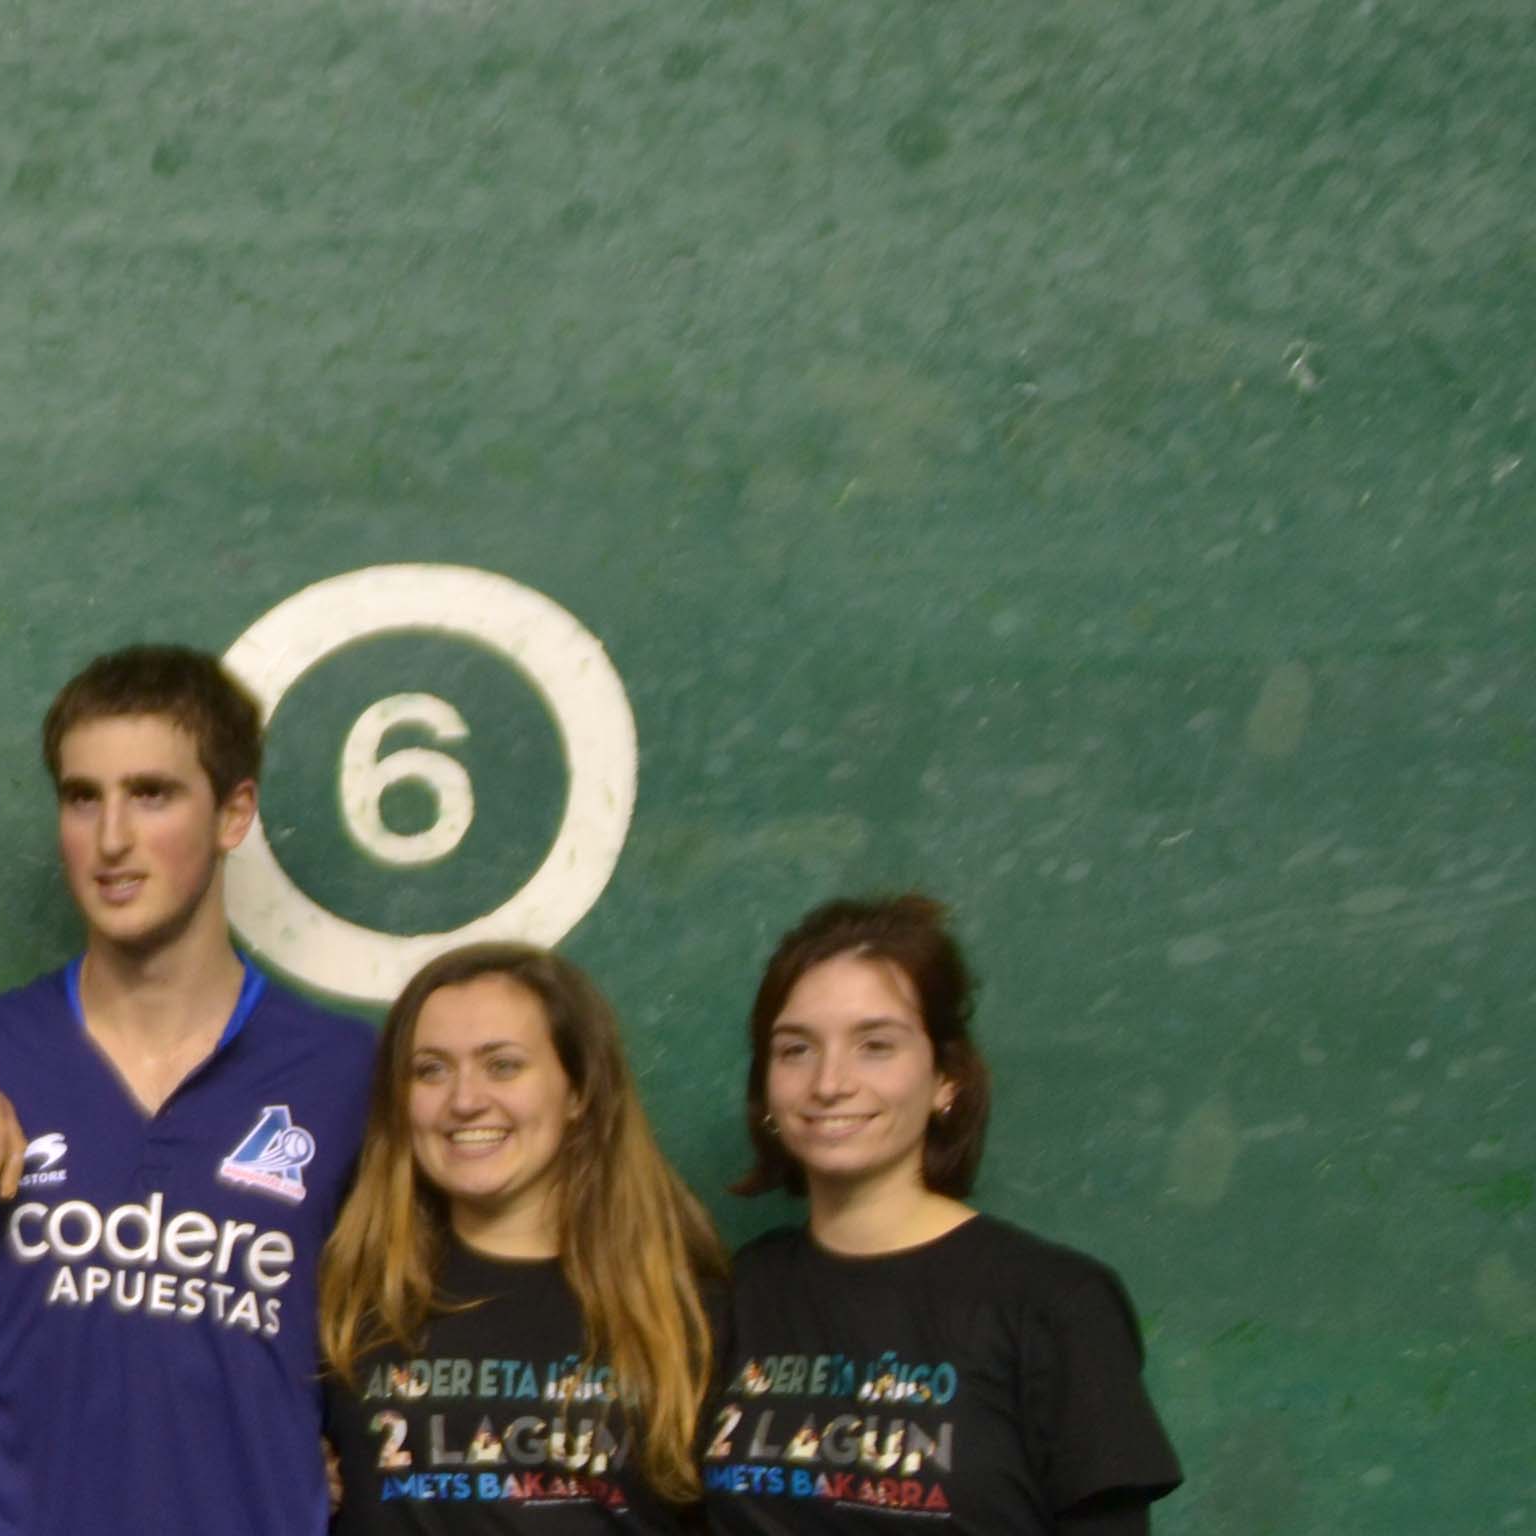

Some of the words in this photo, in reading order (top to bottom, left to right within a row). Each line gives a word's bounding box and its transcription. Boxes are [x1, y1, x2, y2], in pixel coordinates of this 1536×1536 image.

[342, 692, 473, 864] 6
[20, 1169, 68, 1186] STORE
[8, 1192, 295, 1288] codere
[49, 1266, 283, 1337] APUESTAS
[362, 1358, 473, 1400] ANDER
[479, 1358, 539, 1400] ETA
[370, 1408, 412, 1468] 2
[750, 1409, 955, 1477] LAGUN
[380, 1472, 472, 1502] AMETS
[791, 1467, 950, 1511] BAKARRA
